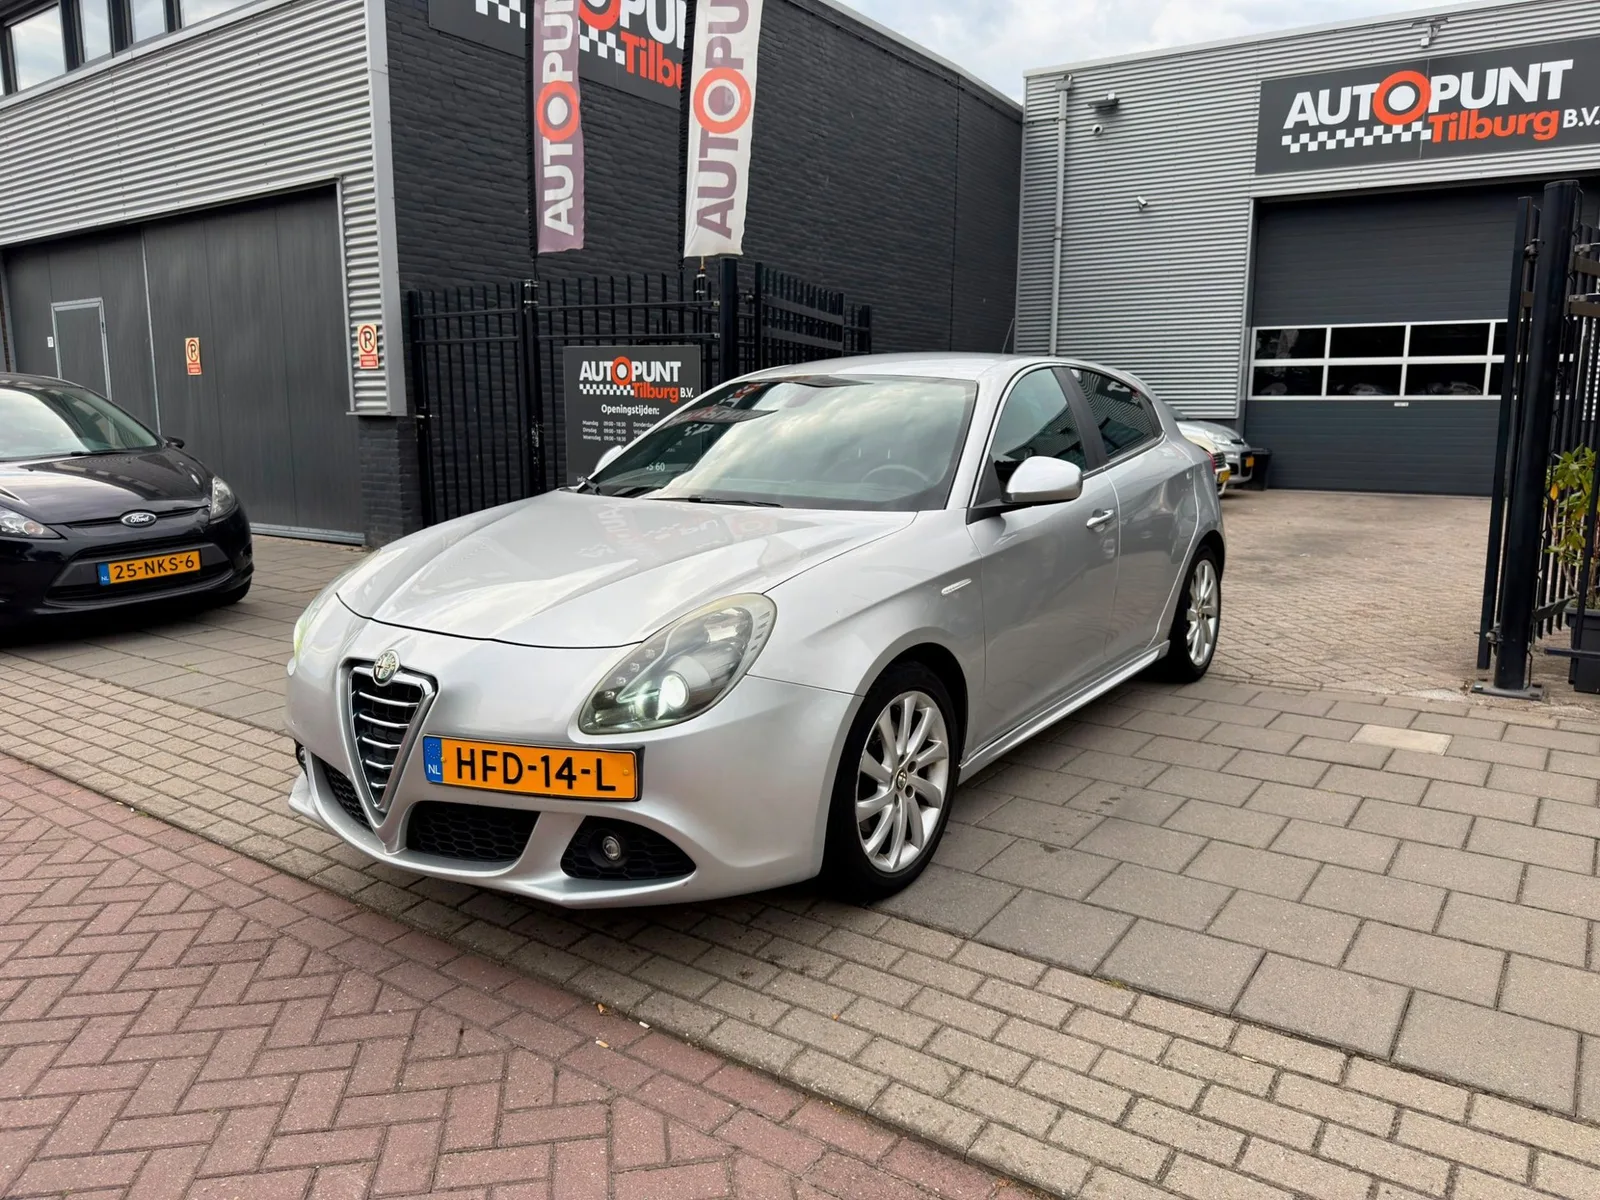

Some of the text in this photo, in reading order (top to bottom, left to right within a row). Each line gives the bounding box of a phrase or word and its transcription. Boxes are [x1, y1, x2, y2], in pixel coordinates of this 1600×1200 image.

[1283, 59, 1574, 129] AUTOPUNT
[1428, 106, 1600, 143] Tilburg B.V.
[579, 356, 682, 386] AUTOPUNT
[631, 382, 694, 404] Tilburg B.V.
[601, 404, 660, 416] Openingstijden:
[655, 462, 666, 472] 60
[130, 514, 150, 523] Ford
[114, 555, 195, 580] 25-NKS-6
[428, 747, 616, 791] NL HFD-14-L
